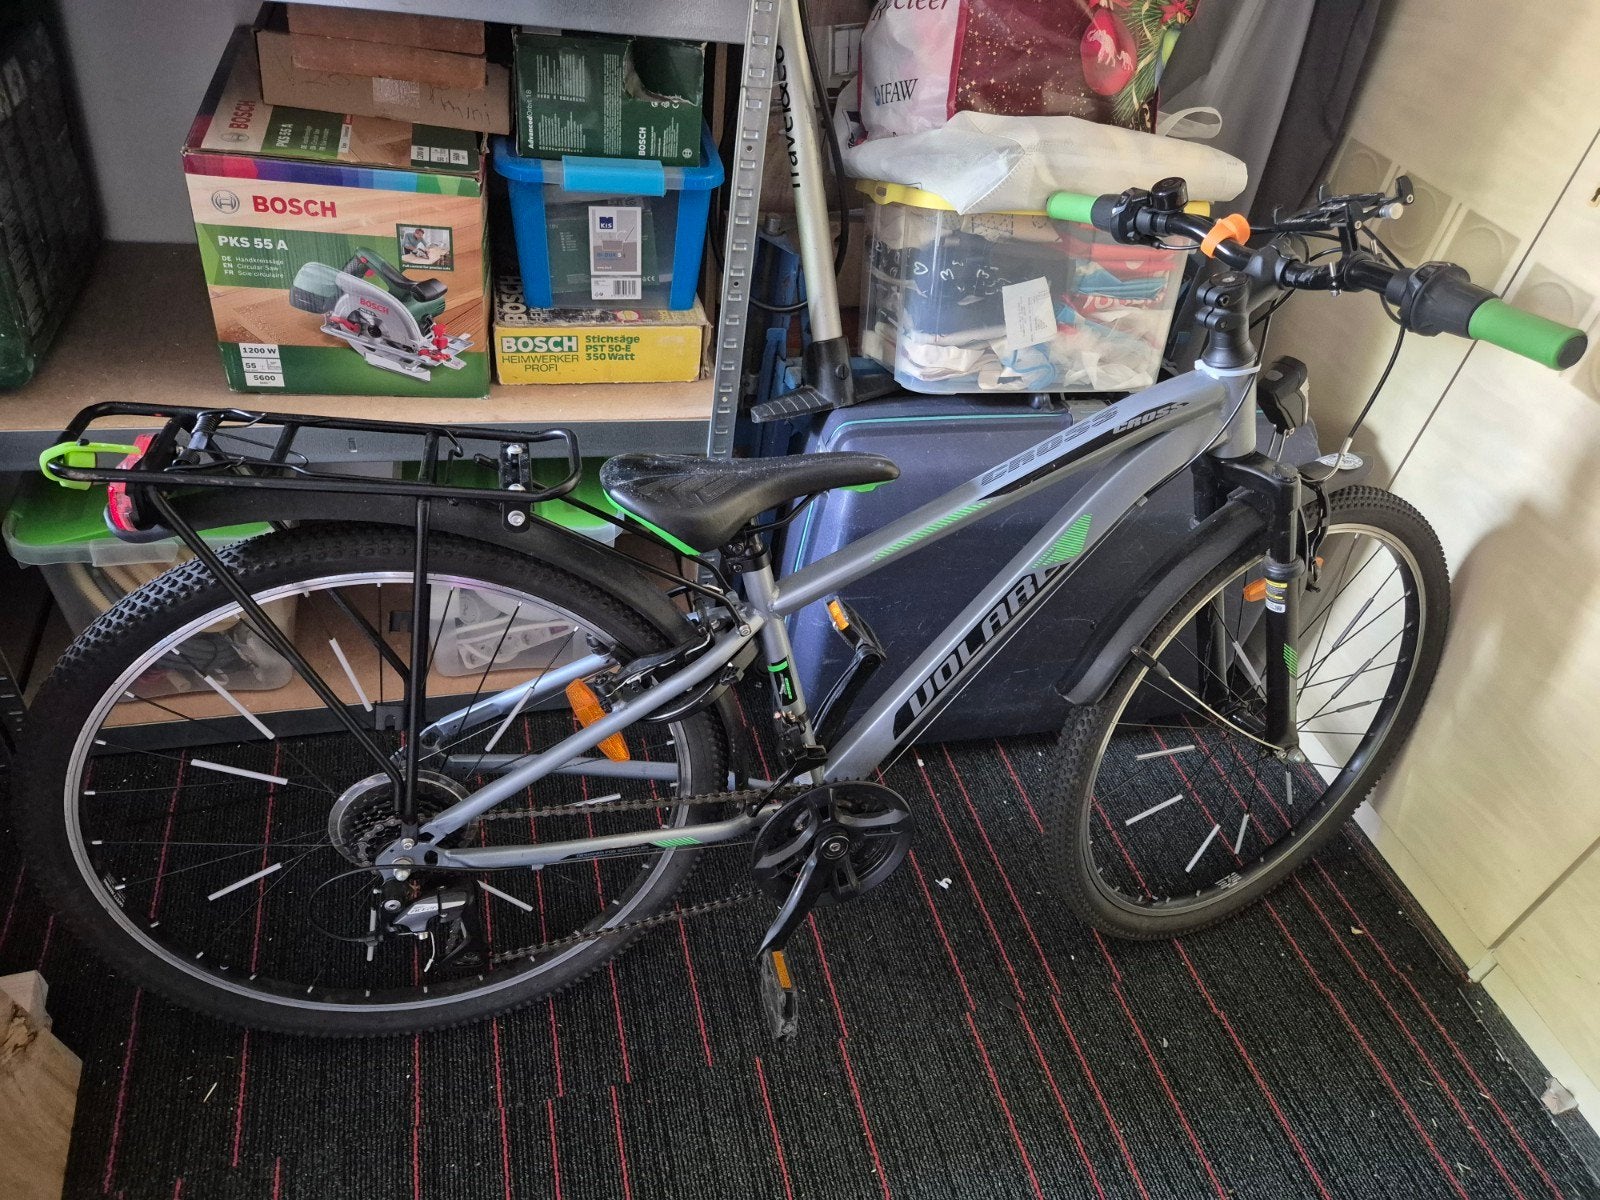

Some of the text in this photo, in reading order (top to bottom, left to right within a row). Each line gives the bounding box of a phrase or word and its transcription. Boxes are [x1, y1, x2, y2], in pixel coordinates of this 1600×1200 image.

[880, 78, 919, 105] IFAW
[229, 100, 256, 130] BOSCH
[638, 127, 647, 157] BOSCH
[252, 195, 338, 218] BOSCH
[217, 235, 289, 251] PKS 55 A
[360, 297, 389, 315] BOSCH
[500, 275, 528, 322] BOSCH
[502, 335, 640, 353] BOSCH Stichsäge
[585, 344, 631, 352] PST 50-E
[502, 354, 579, 364] HEIMWERKER
[585, 353, 635, 361] 350 Watt
[524, 363, 558, 372] PROFI
[981, 406, 1119, 486] CROSS
